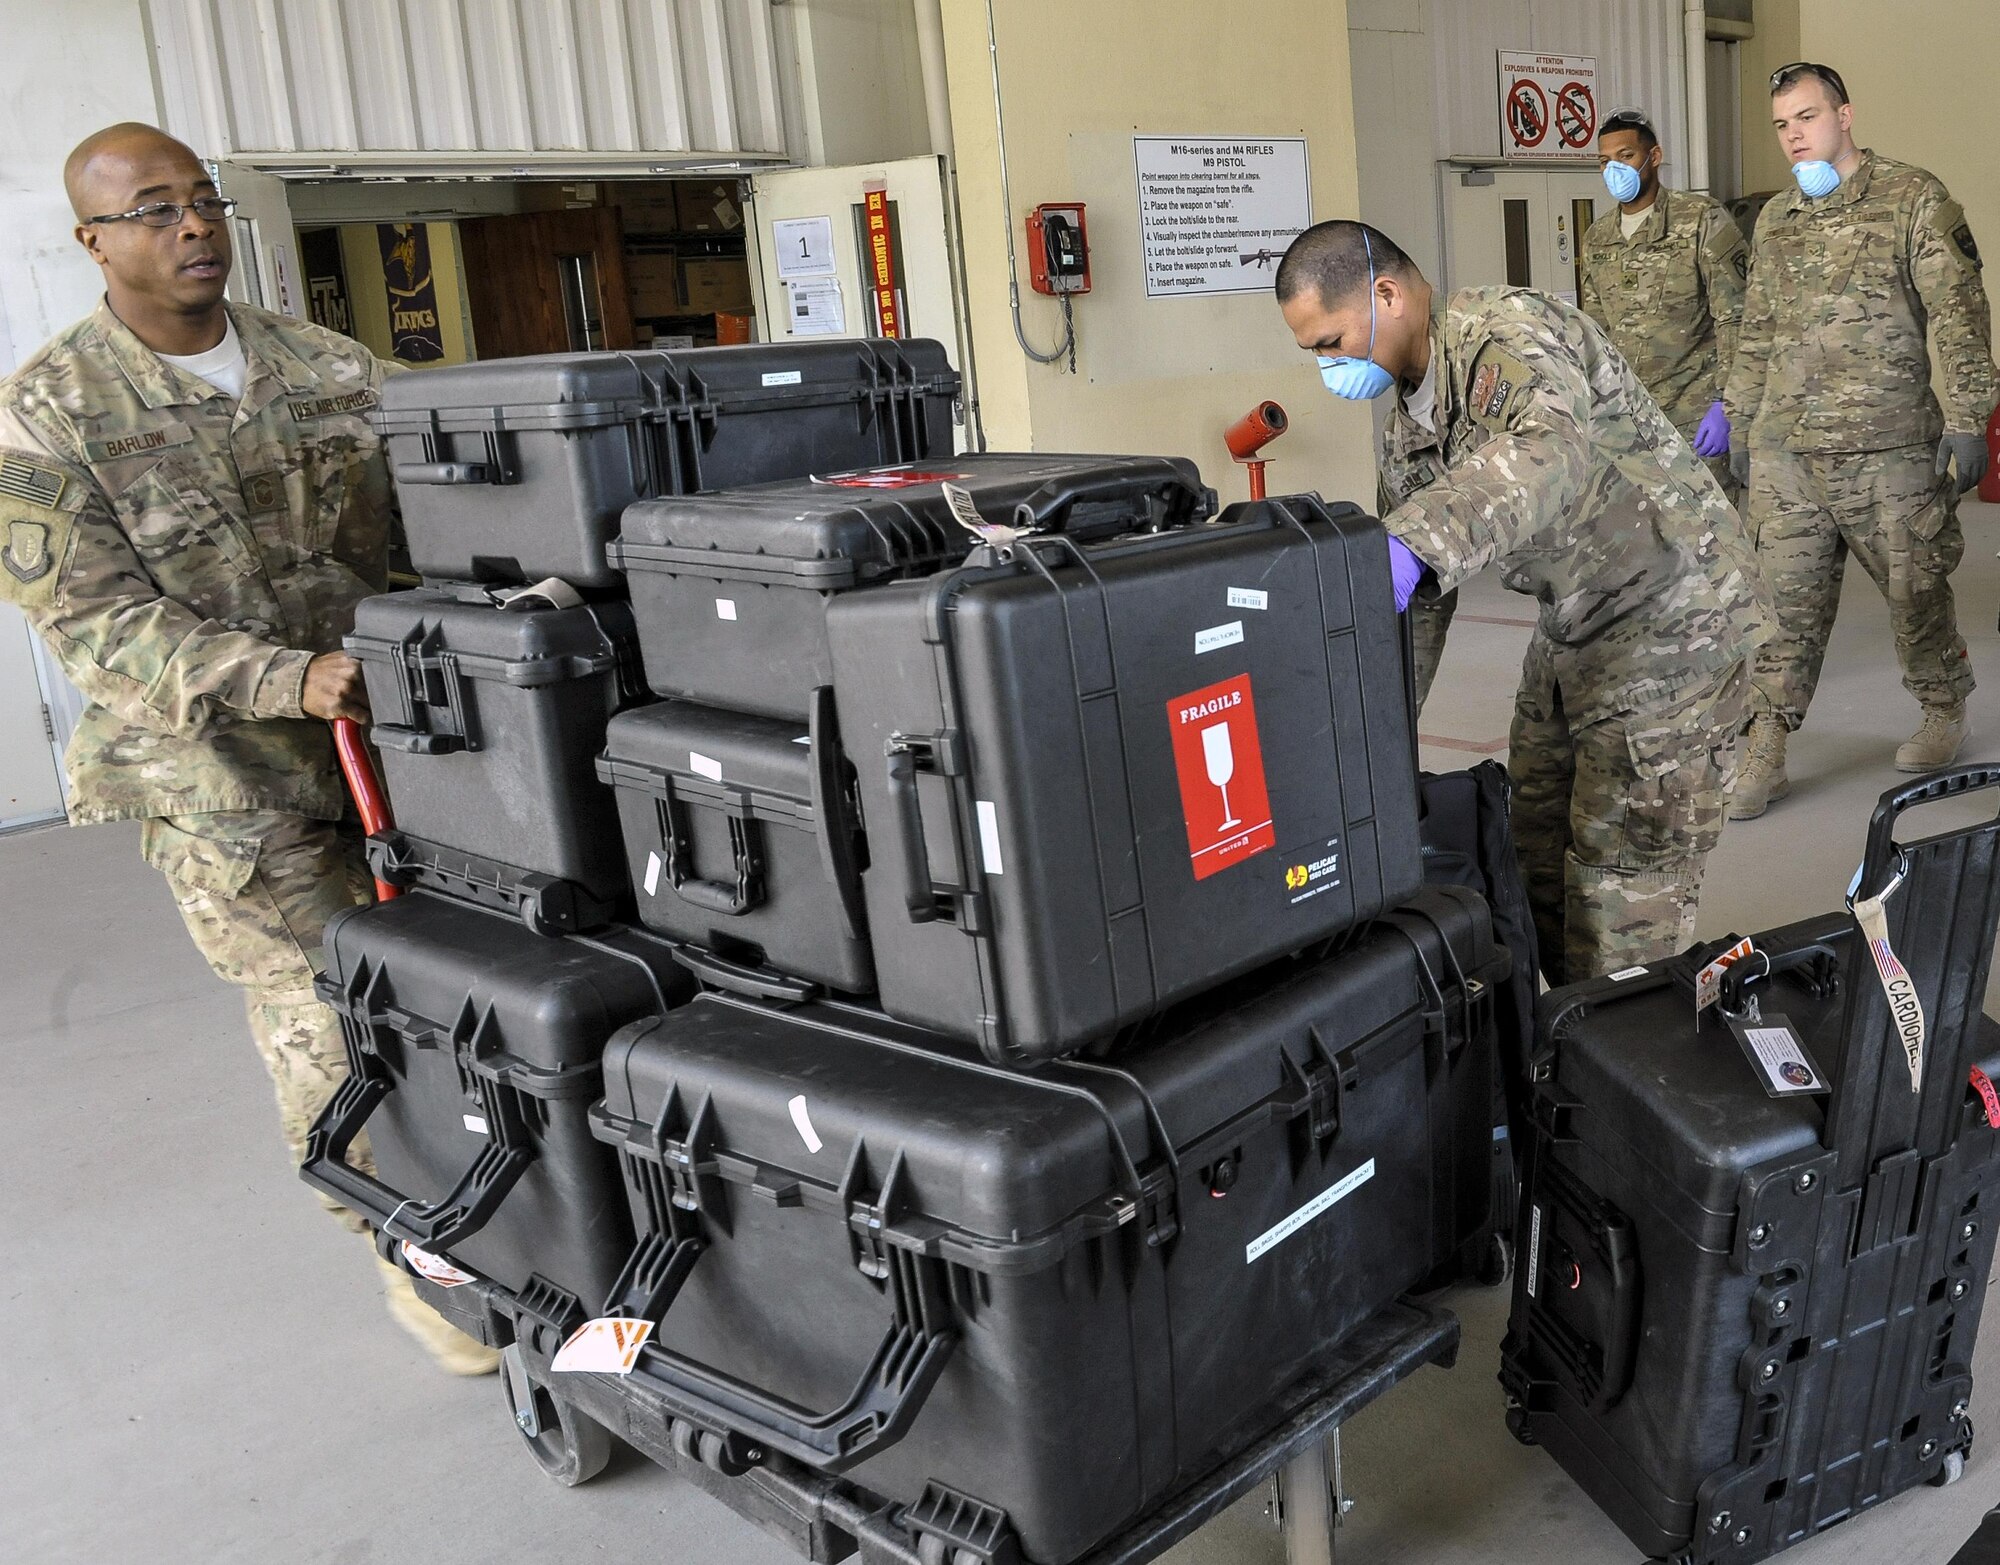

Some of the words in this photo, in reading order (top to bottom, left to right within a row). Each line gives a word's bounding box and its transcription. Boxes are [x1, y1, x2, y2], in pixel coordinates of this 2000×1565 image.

[1536, 56, 1564, 65] ATTENTION
[1504, 64, 1535, 73] EXPLOSIVES
[1541, 67, 1564, 75] WEAPONS
[1566, 68, 1594, 76] PROHIBITED
[1170, 145, 1214, 154] M16-series
[1216, 146, 1230, 154] and
[1232, 146, 1244, 154] M4
[1246, 146, 1274, 154] RIFLES
[1203, 158, 1215, 167] M9
[1217, 158, 1246, 167] PISTOL
[1142, 172, 1156, 180] Point
[1191, 172, 1212, 181] clearing
[1213, 172, 1228, 180] barrel
[1143, 186, 1149, 195] 1.
[1150, 186, 1174, 195] Remove
[1175, 185, 1185, 194] the
[1187, 185, 1215, 196] magazine
[1216, 185, 1230, 194] from
[1231, 185, 1240, 193] the
[1242, 184, 1254, 193] rifle.
[869, 193, 882, 210] ER
[1144, 202, 1150, 210] 2.
[1151, 201, 1168, 210] Place
[1169, 201, 1179, 209] the
[1180, 202, 1203, 211] weapon
[871, 215, 884, 230] IN
[1145, 217, 1151, 226] 3.
[1152, 216, 1167, 226] Lock
[1168, 216, 1178, 225] the
[1180, 215, 1207, 225] bolt/slide
[1208, 216, 1214, 224] to
[1215, 215, 1225, 224] the
[1226, 216, 1239, 224] rear.
[1146, 232, 1152, 241] 4.
[1153, 231, 1177, 242] Visually
[1178, 231, 1201, 241] inspect
[1202, 230, 1211, 239] the
[1261, 229, 1271, 238] any
[799, 236, 810, 258] 1
[1148, 248, 1153, 256] 5.
[1155, 248, 1164, 256] Let
[1166, 247, 1175, 255] the
[1177, 246, 1204, 255] bolt/slide
[1206, 247, 1213, 256] go
[1215, 244, 1238, 253] forward.
[873, 234, 889, 286] CHRONIC
[1149, 263, 1154, 271] 6.
[1156, 262, 1172, 271] Place
[1174, 262, 1184, 271] the
[1185, 261, 1209, 271] weapon
[1219, 259, 1233, 268] safe.
[1150, 278, 1156, 287] 7.
[1157, 278, 1175, 286] Insert
[1176, 276, 1206, 287] magazine.
[880, 291, 892, 308] NO
[883, 312, 893, 324] IS
[316, 399, 336, 414] AIR
[336, 390, 372, 412] FORCE
[106, 430, 166, 457] BARLOW
[1180, 691, 1241, 725] FRAGILE
[1219, 841, 1242, 855] UNITED
[1322, 864, 1336, 876] CASE
[1889, 980, 1921, 1069] CARDIOHEL
